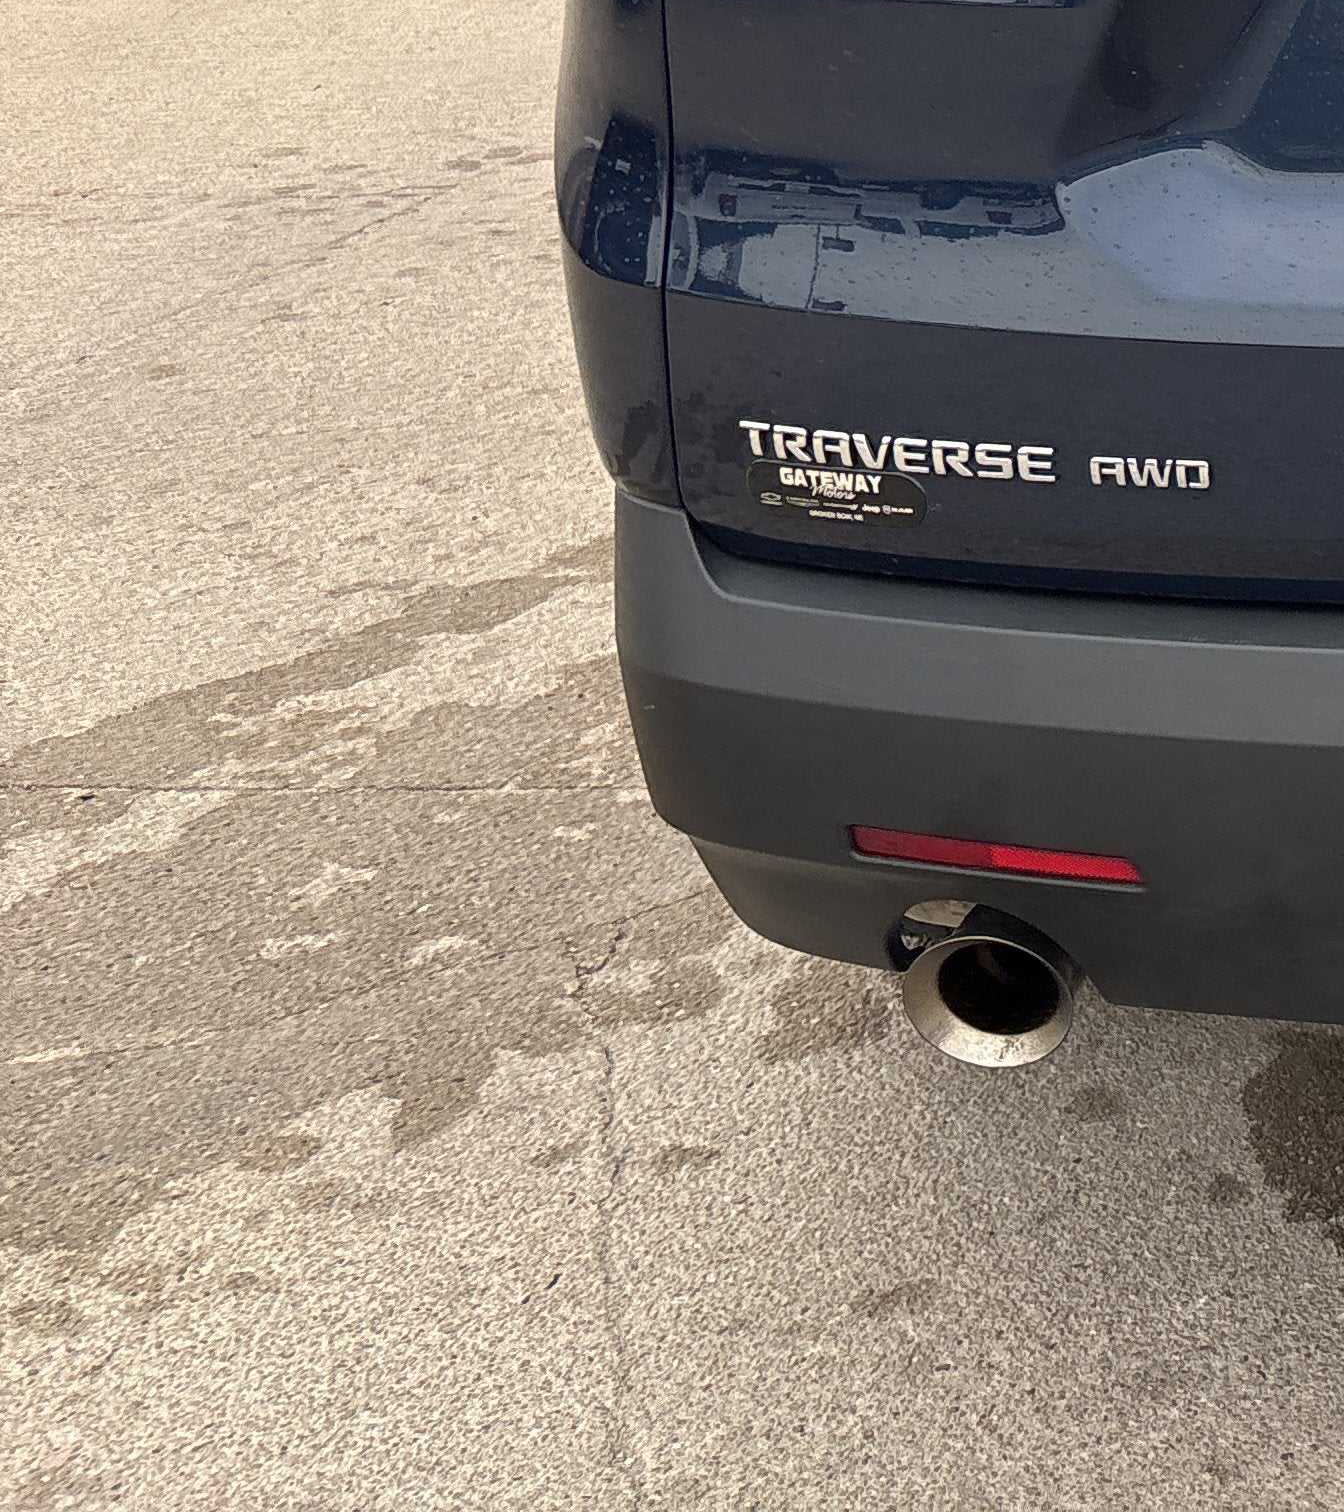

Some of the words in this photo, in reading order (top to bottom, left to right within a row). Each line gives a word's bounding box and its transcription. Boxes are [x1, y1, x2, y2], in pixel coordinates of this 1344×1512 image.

[739, 420, 1059, 483] TRAVERSE
[1089, 456, 1209, 489] AWD
[779, 467, 882, 493] GATEWAY
[809, 485, 857, 500] Motors
